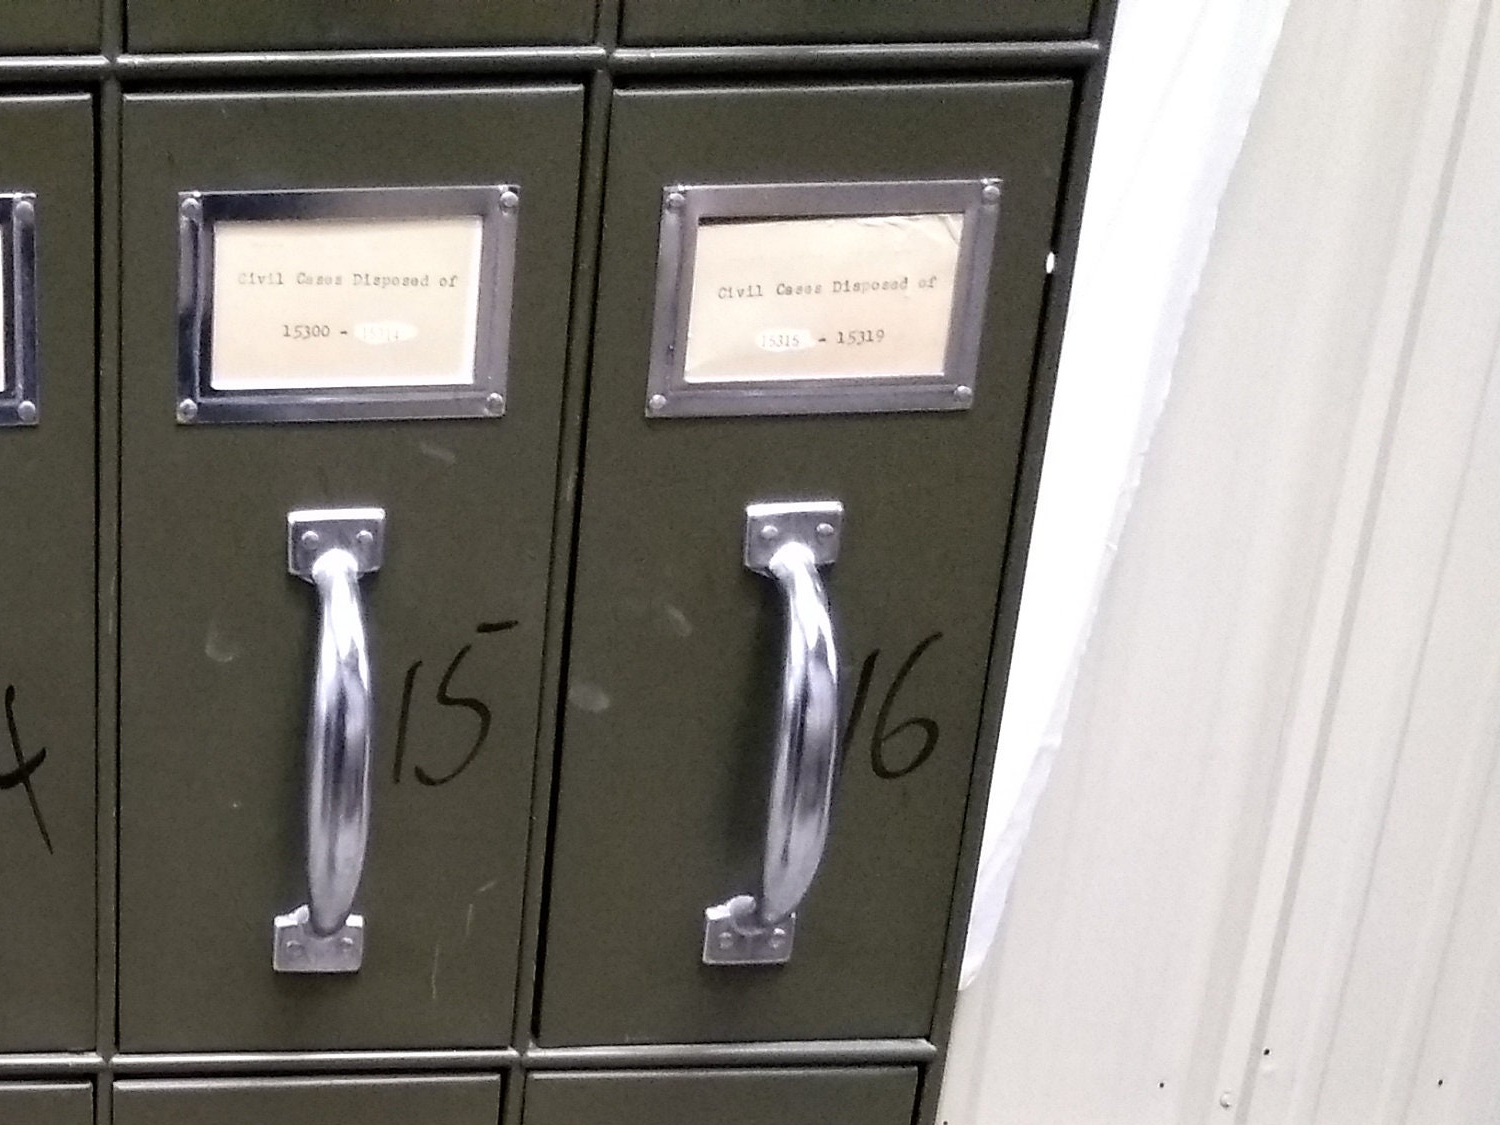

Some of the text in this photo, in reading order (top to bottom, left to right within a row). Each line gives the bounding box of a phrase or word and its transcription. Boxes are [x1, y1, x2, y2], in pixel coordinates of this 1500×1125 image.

[238, 272, 458, 288] Civil Cases Disposed of
[718, 275, 937, 299] Civil Cases Disposed of
[283, 325, 330, 339] 15300
[836, 329, 885, 345] 15319
[393, 621, 518, 786] 15
[837, 631, 943, 779] 16
